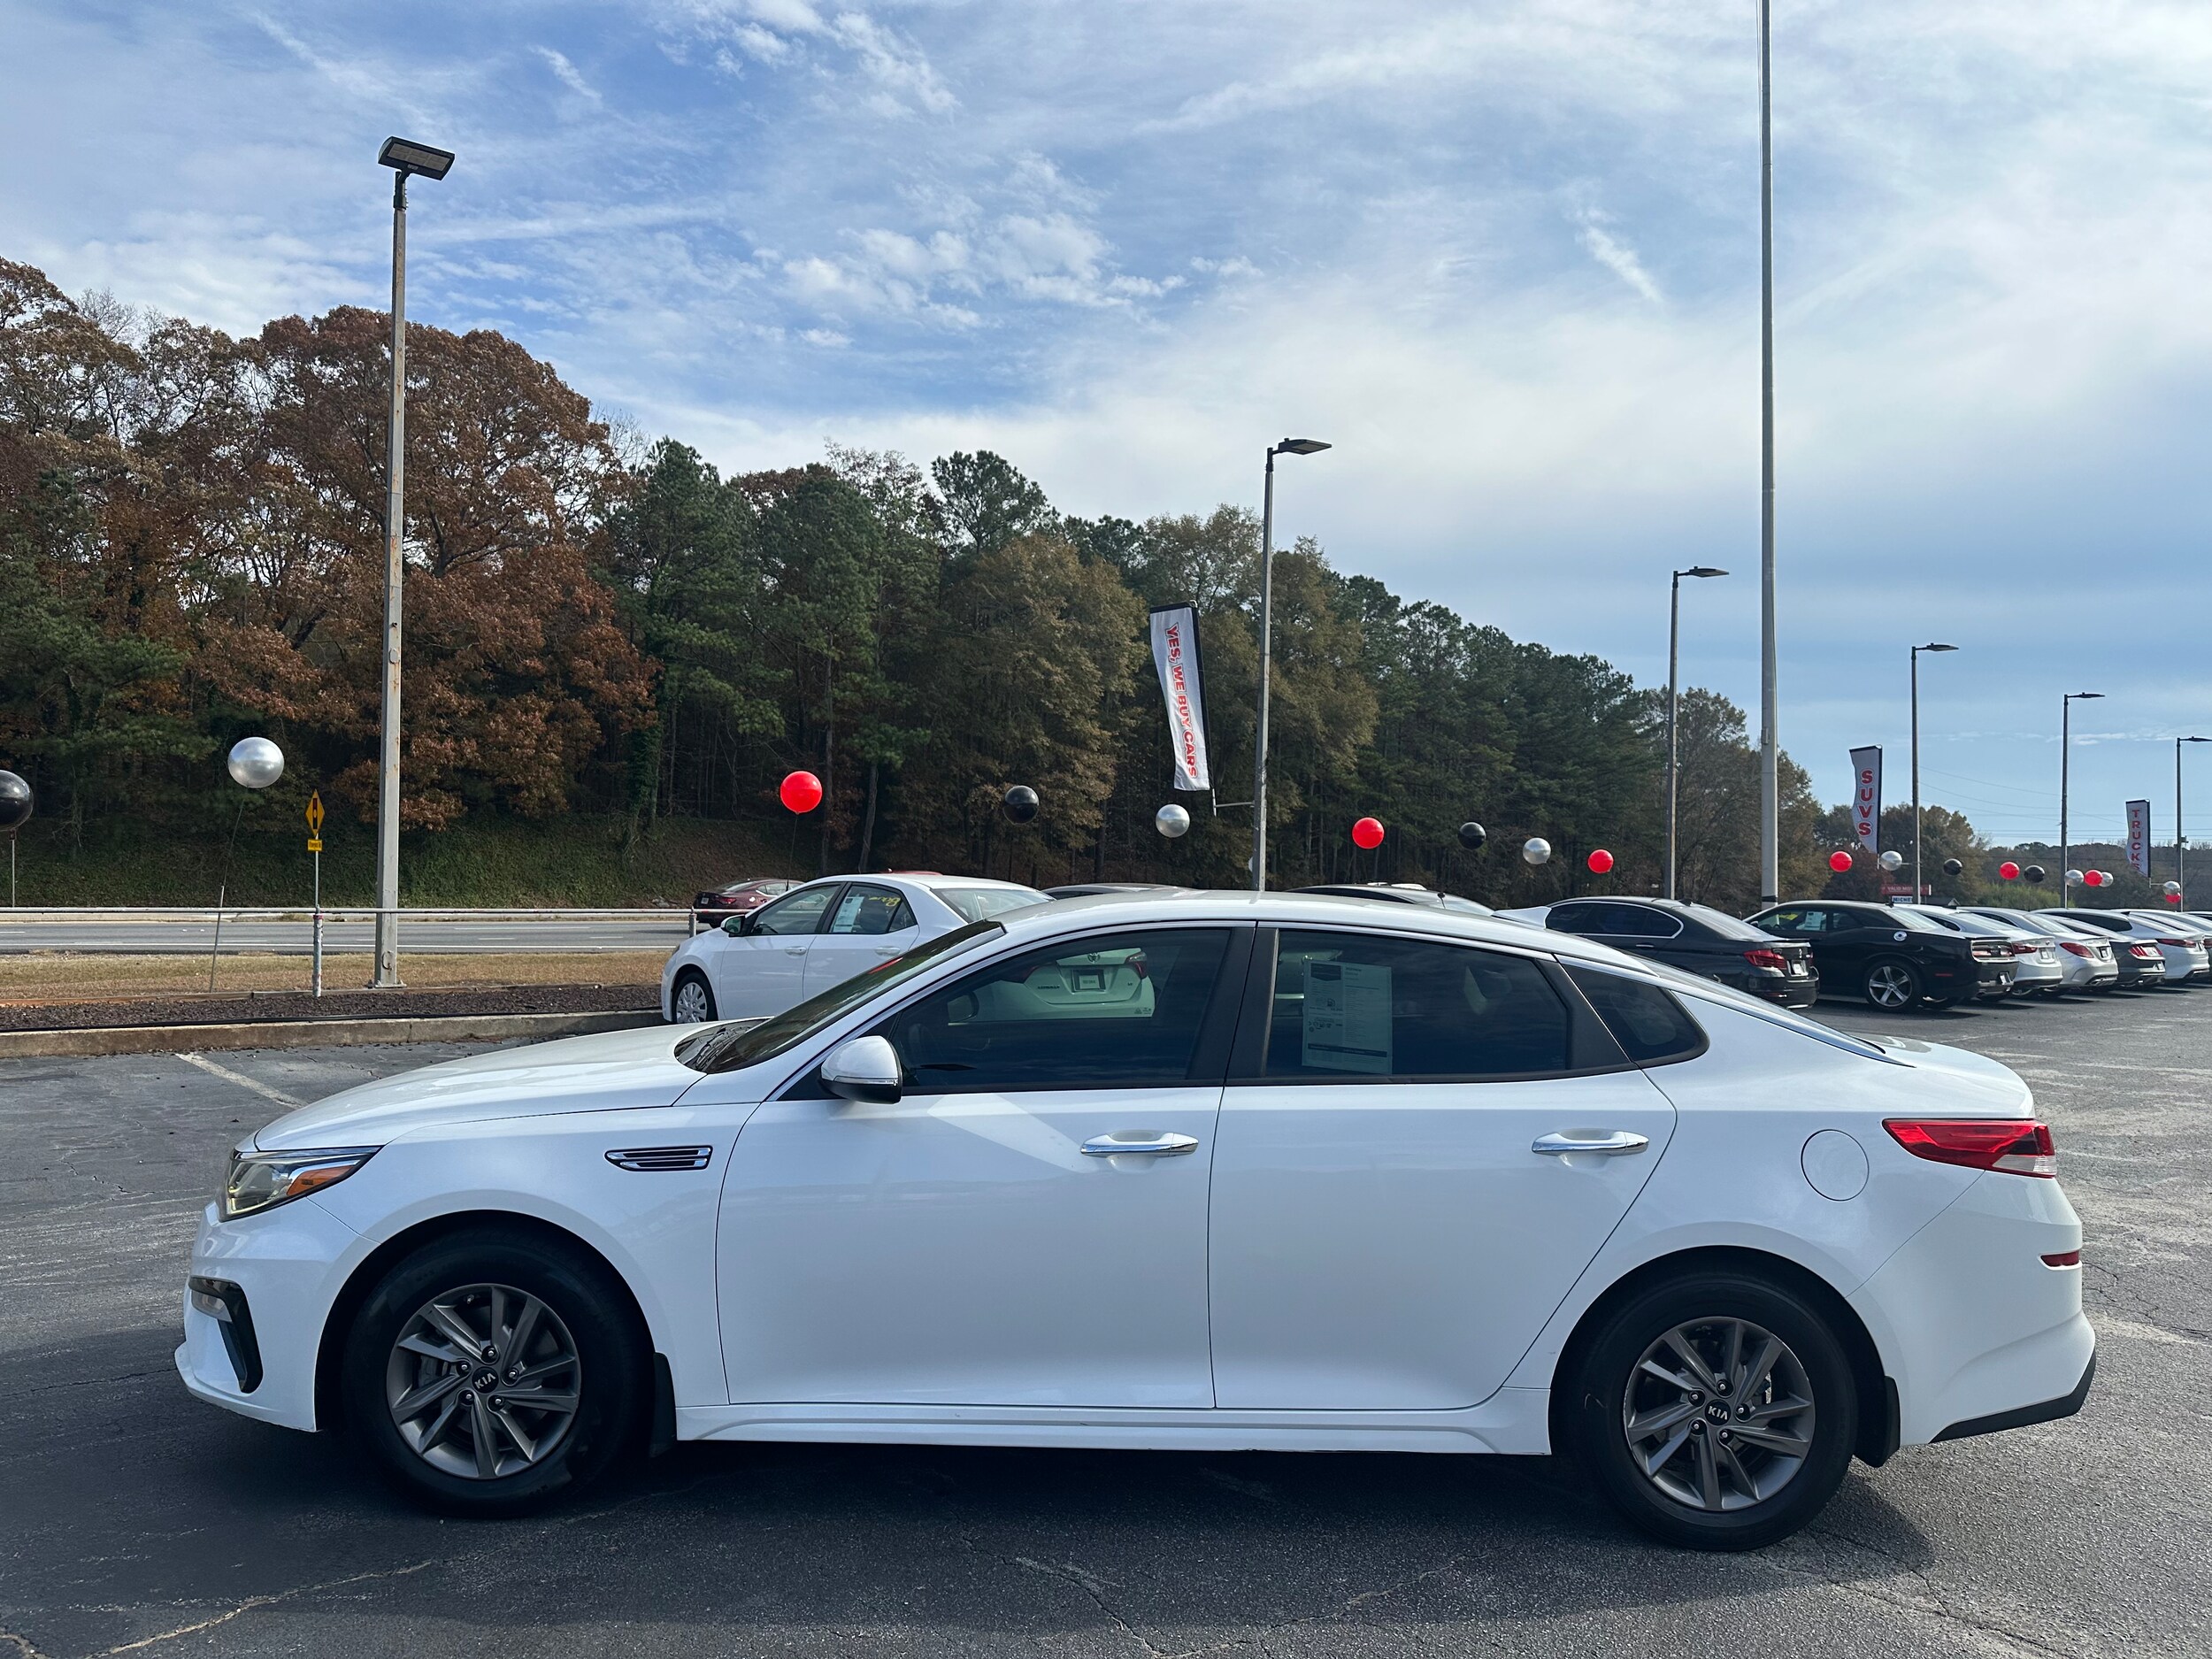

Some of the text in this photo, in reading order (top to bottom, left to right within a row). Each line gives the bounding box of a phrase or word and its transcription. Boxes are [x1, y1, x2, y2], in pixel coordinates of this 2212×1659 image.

[1165, 623, 1198, 780] YES, WE BUY CARS
[1858, 769, 1874, 836] SUVS
[474, 1372, 496, 1389] KIA
[1708, 1406, 1728, 1420] KIA
